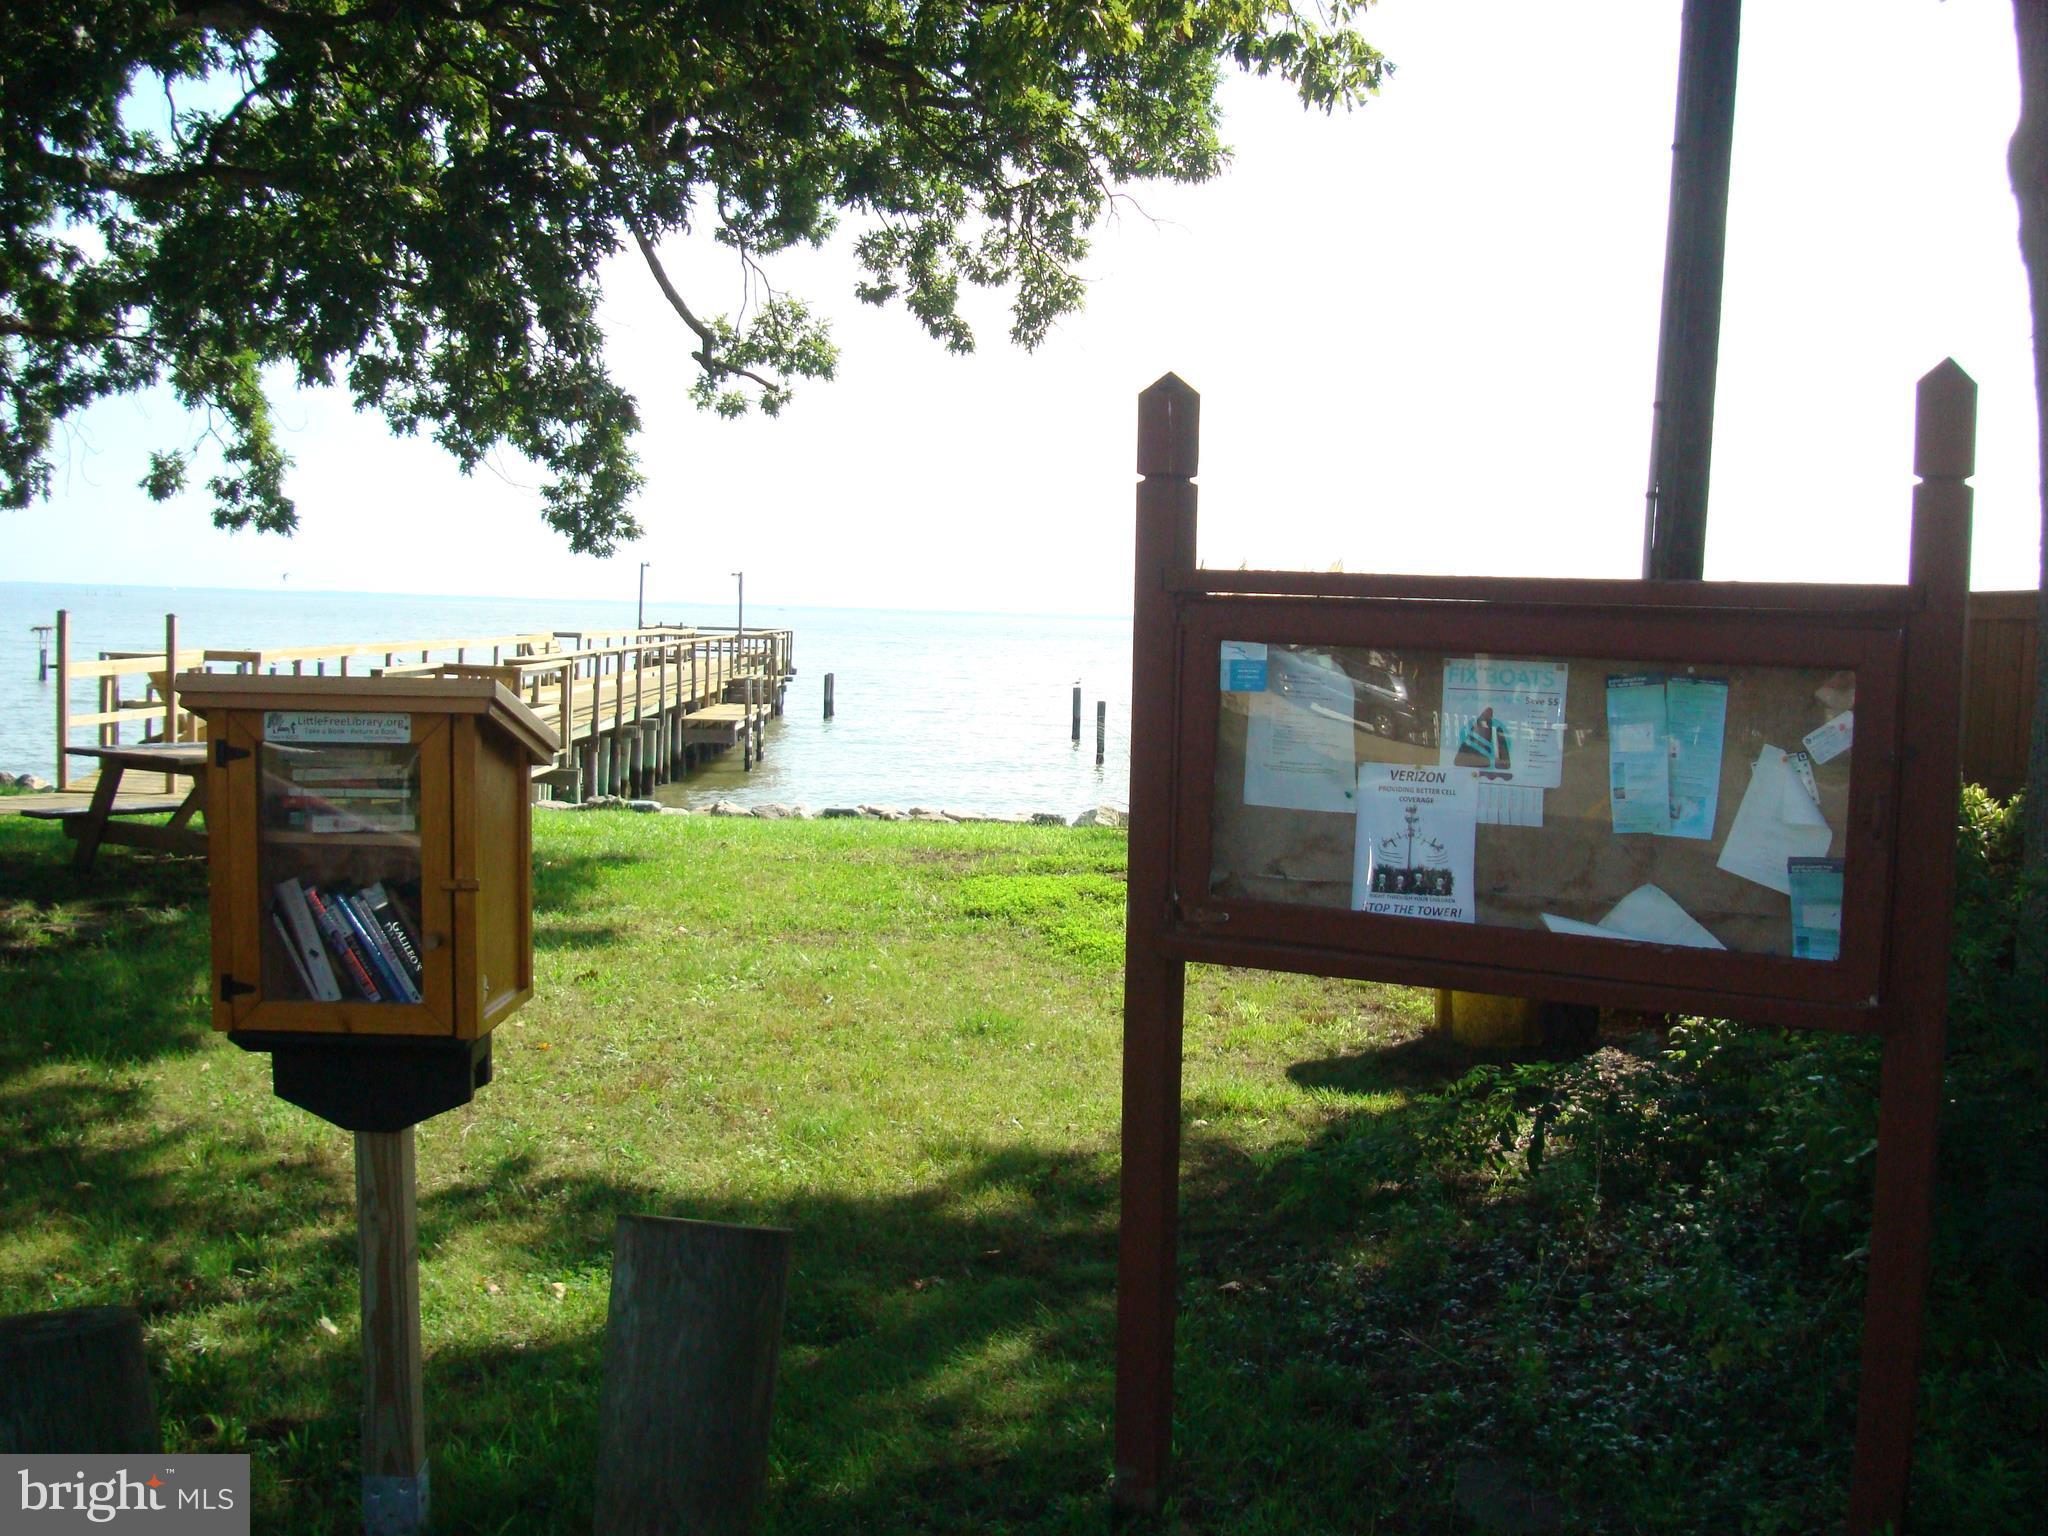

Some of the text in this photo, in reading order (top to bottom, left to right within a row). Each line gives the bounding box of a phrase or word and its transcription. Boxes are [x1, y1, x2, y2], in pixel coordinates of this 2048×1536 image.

[1447, 666, 1478, 684] FIX
[297, 716, 404, 729] LittleFreeLibrary.org
[1390, 769, 1447, 783] VERIZON
[1378, 785, 1456, 796] PROVIDING BETTER CELL
[1399, 796, 1434, 804] COVERAGE
[1393, 904, 1414, 915] THE
[1417, 906, 1463, 918] TOWER!
[391, 921, 423, 972] GALILEO'S
